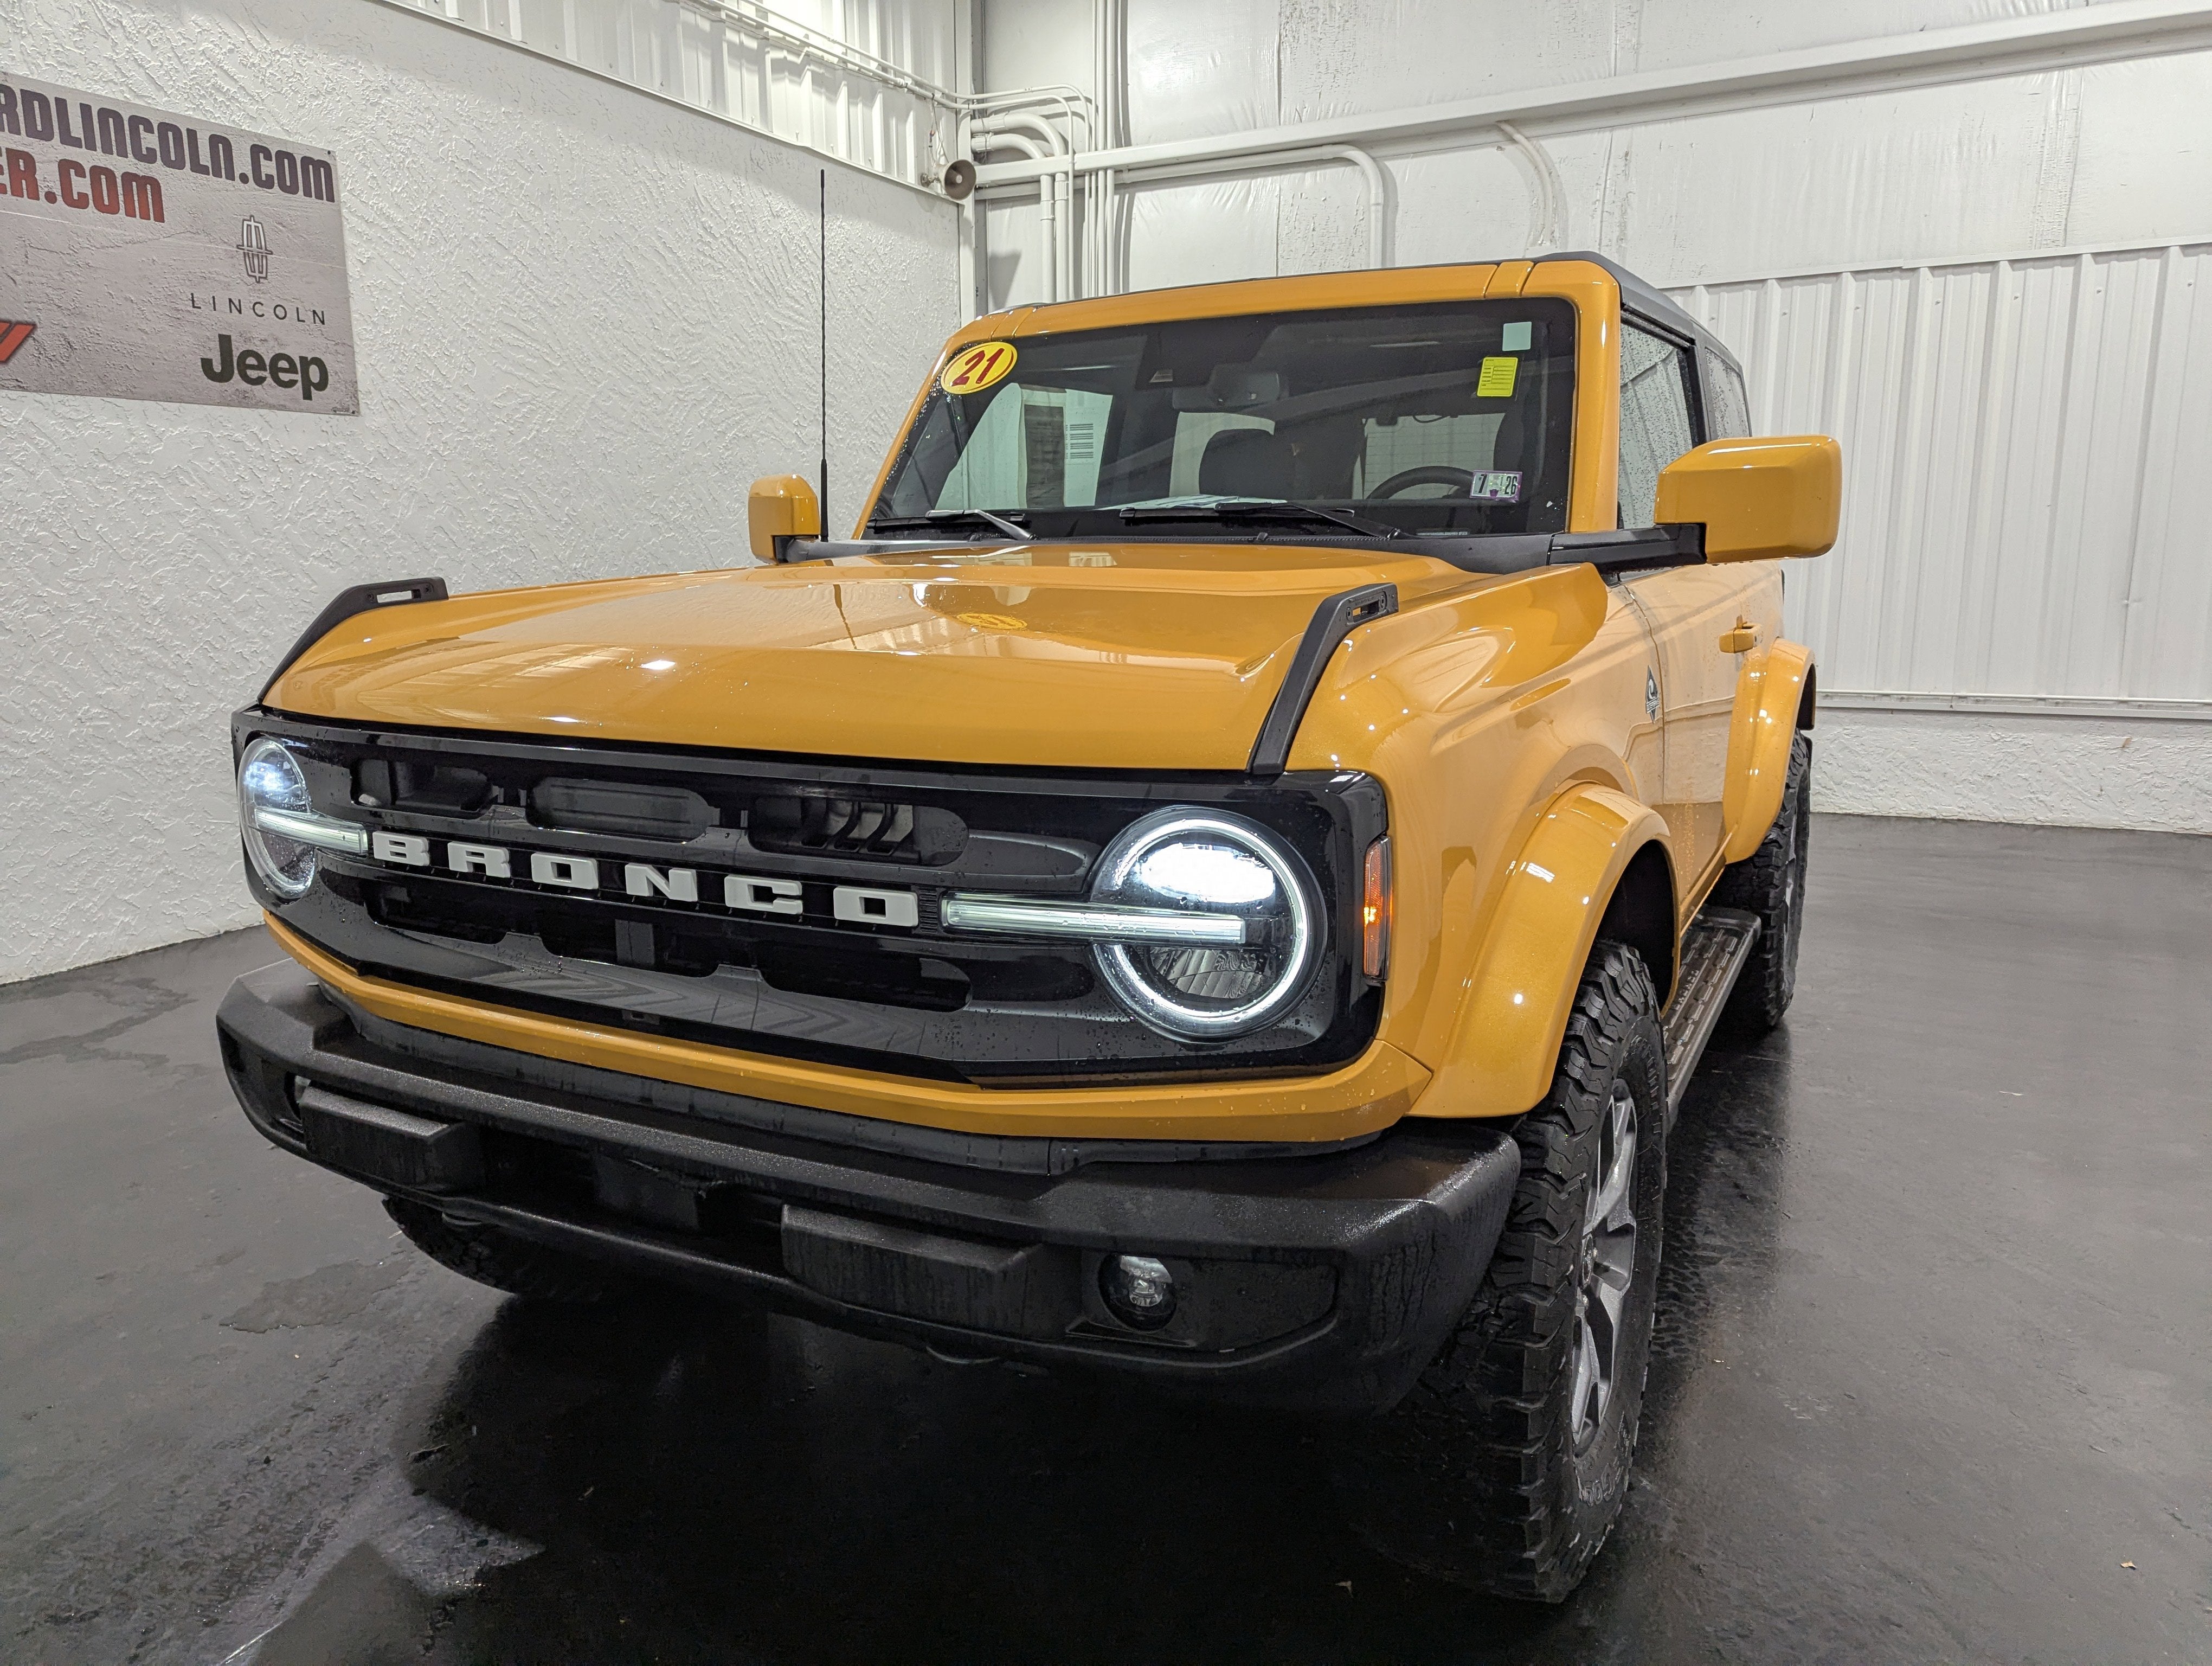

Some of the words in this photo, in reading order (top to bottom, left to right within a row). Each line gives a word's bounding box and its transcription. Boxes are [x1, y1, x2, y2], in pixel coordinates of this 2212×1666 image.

[0, 146, 164, 223] R.COM
[190, 292, 326, 325] LINCOLN
[200, 334, 329, 401] Jeep
[950, 348, 1005, 387] 21
[1478, 473, 1488, 494] 7
[1504, 476, 1517, 495] 26
[372, 830, 918, 928] BRONCO
